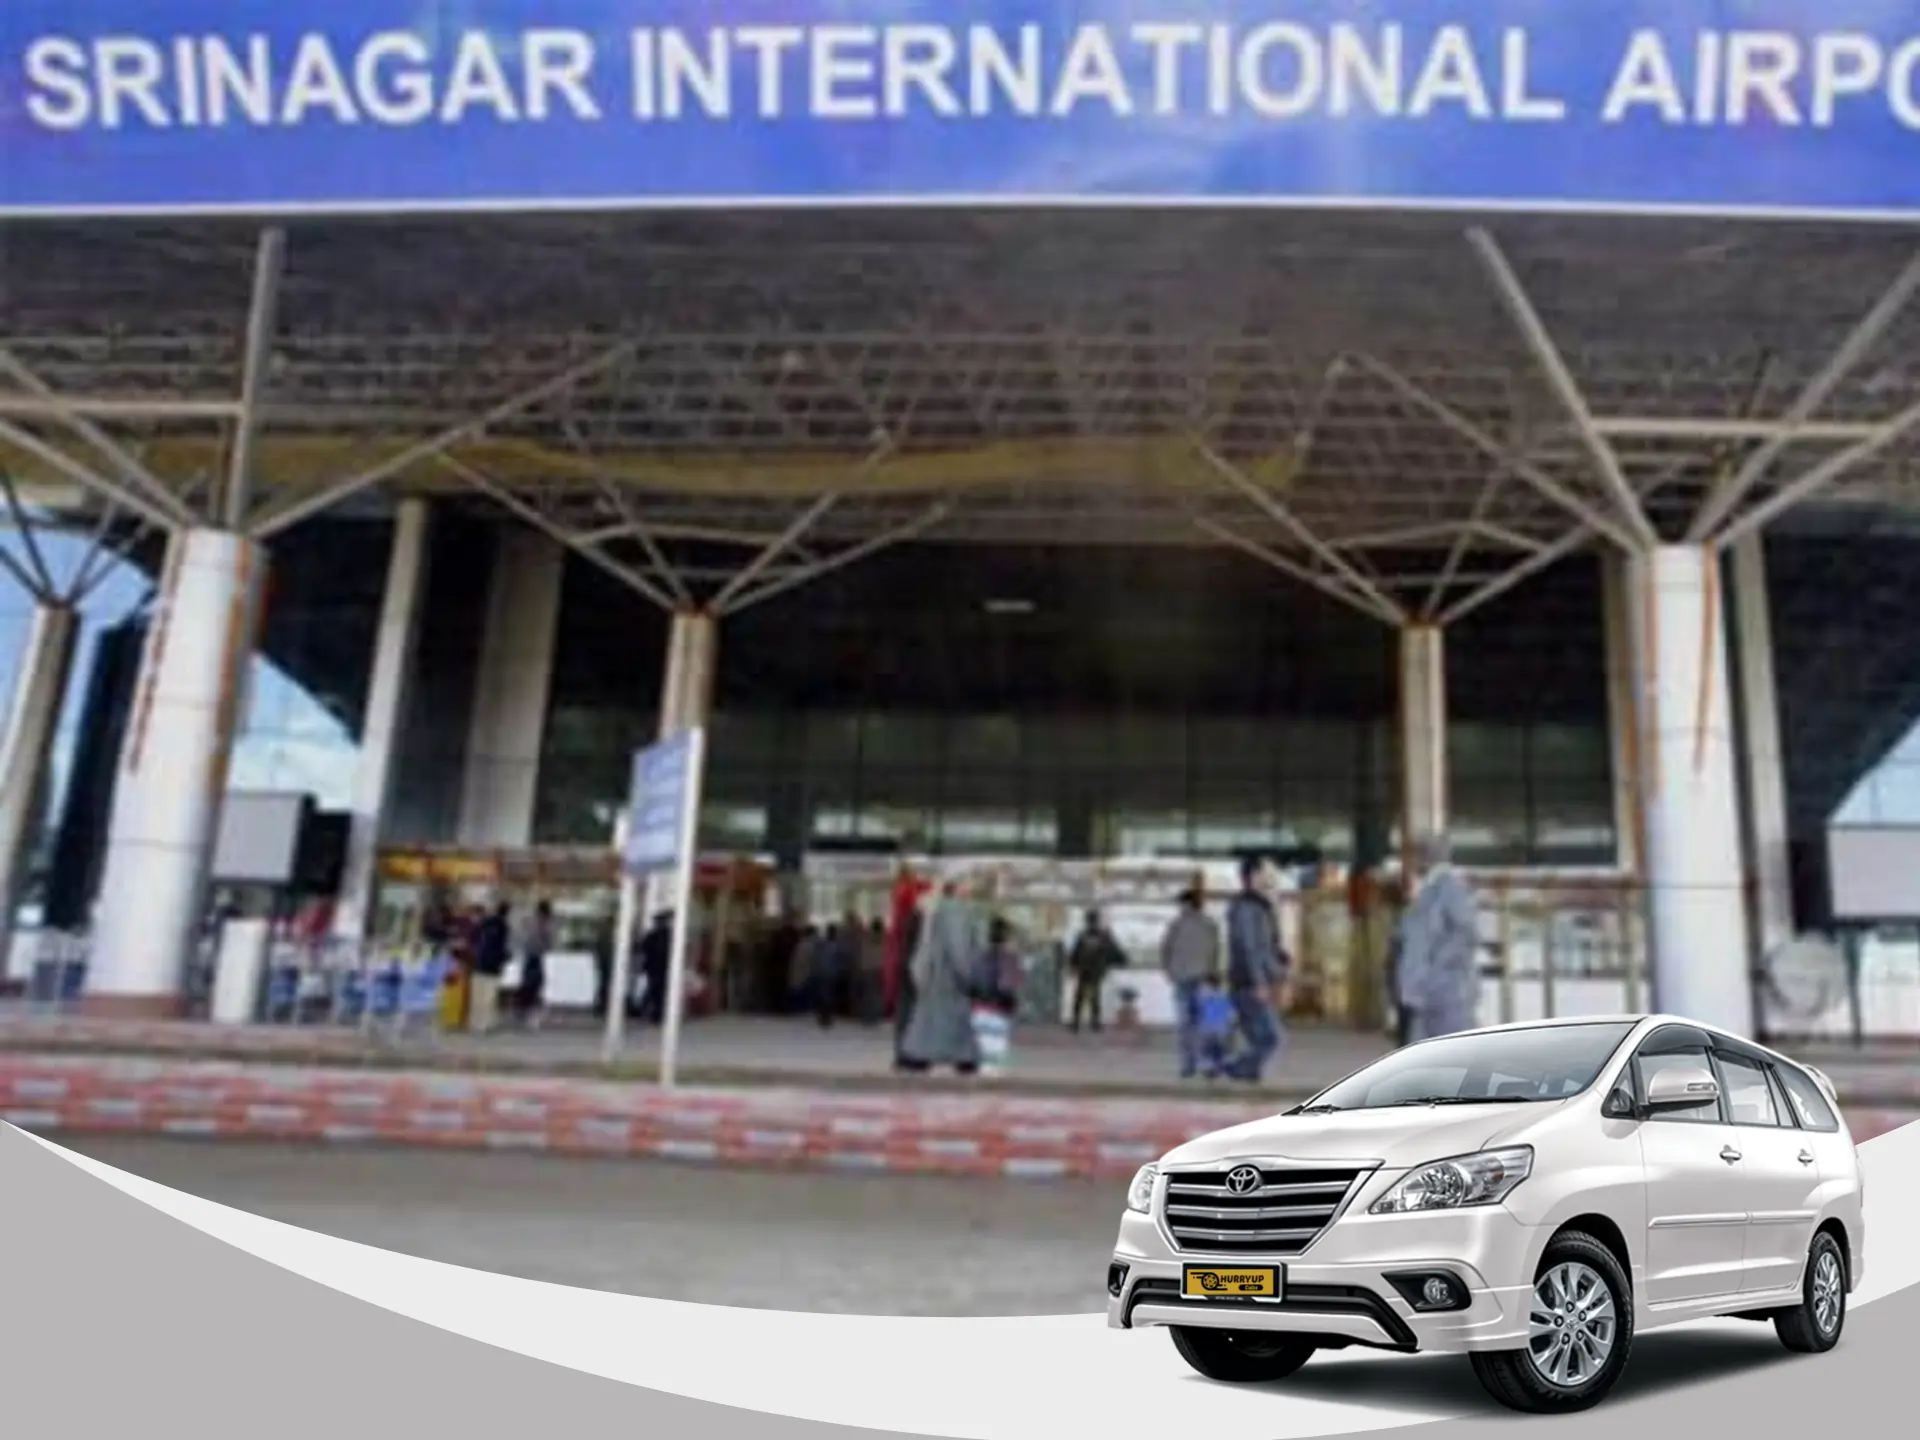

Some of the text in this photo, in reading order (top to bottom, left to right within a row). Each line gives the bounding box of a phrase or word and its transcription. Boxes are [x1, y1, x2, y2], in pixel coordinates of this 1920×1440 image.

[25, 30, 600, 128] SRINAGAR
[633, 22, 1566, 121] INTERNATIONAL
[1220, 1275, 1264, 1284] HURRYUP
